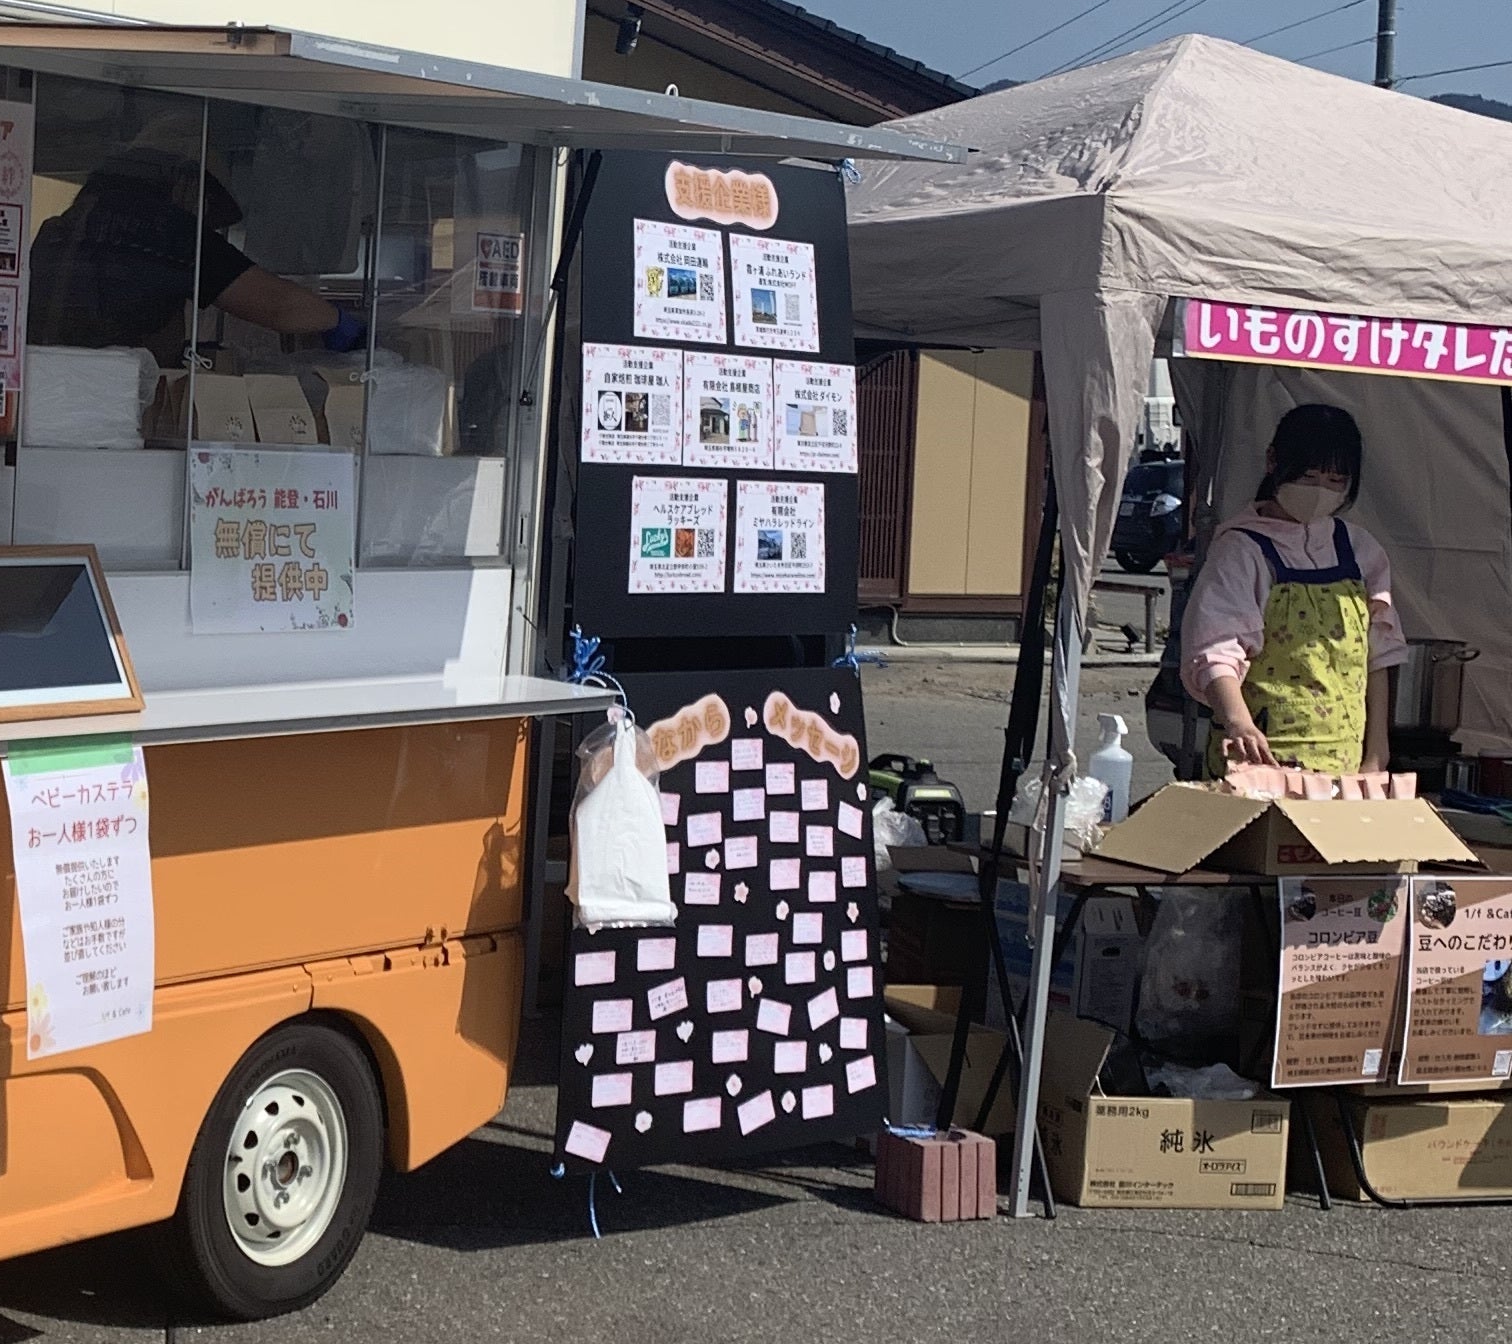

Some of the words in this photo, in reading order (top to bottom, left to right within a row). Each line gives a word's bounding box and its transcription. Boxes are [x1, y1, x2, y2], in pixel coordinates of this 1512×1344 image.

[492, 239, 519, 259] AED
[205, 487, 268, 509] がんばろう
[214, 518, 317, 560] 無償にて
[251, 561, 329, 603] 提供中
[31, 780, 135, 809] ベビーカステラ
[28, 814, 138, 849] お一人様1袋ずつ
[1486, 908, 1512, 920] &Ca
[1308, 930, 1379, 944] コロンビア豆
[1418, 935, 1512, 952] 豆へのこだわ
